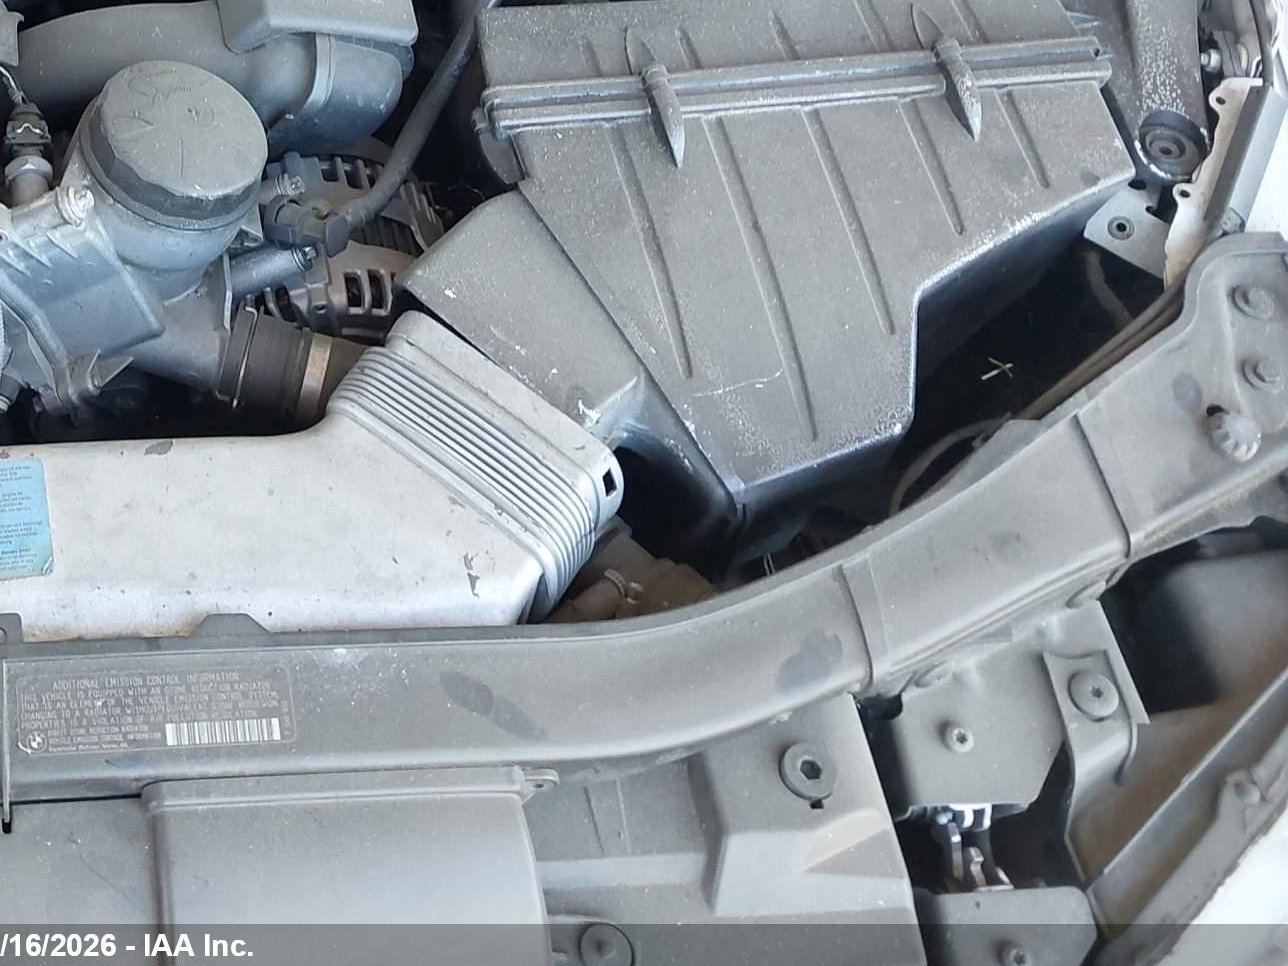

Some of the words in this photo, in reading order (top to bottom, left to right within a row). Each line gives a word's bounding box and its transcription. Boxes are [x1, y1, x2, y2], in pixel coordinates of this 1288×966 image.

[53, 679, 99, 691] ADDITIONAL
[106, 676, 142, 687] EMISSION
[147, 674, 180, 685] CONTROL
[186, 672, 239, 683] INFORMATION
